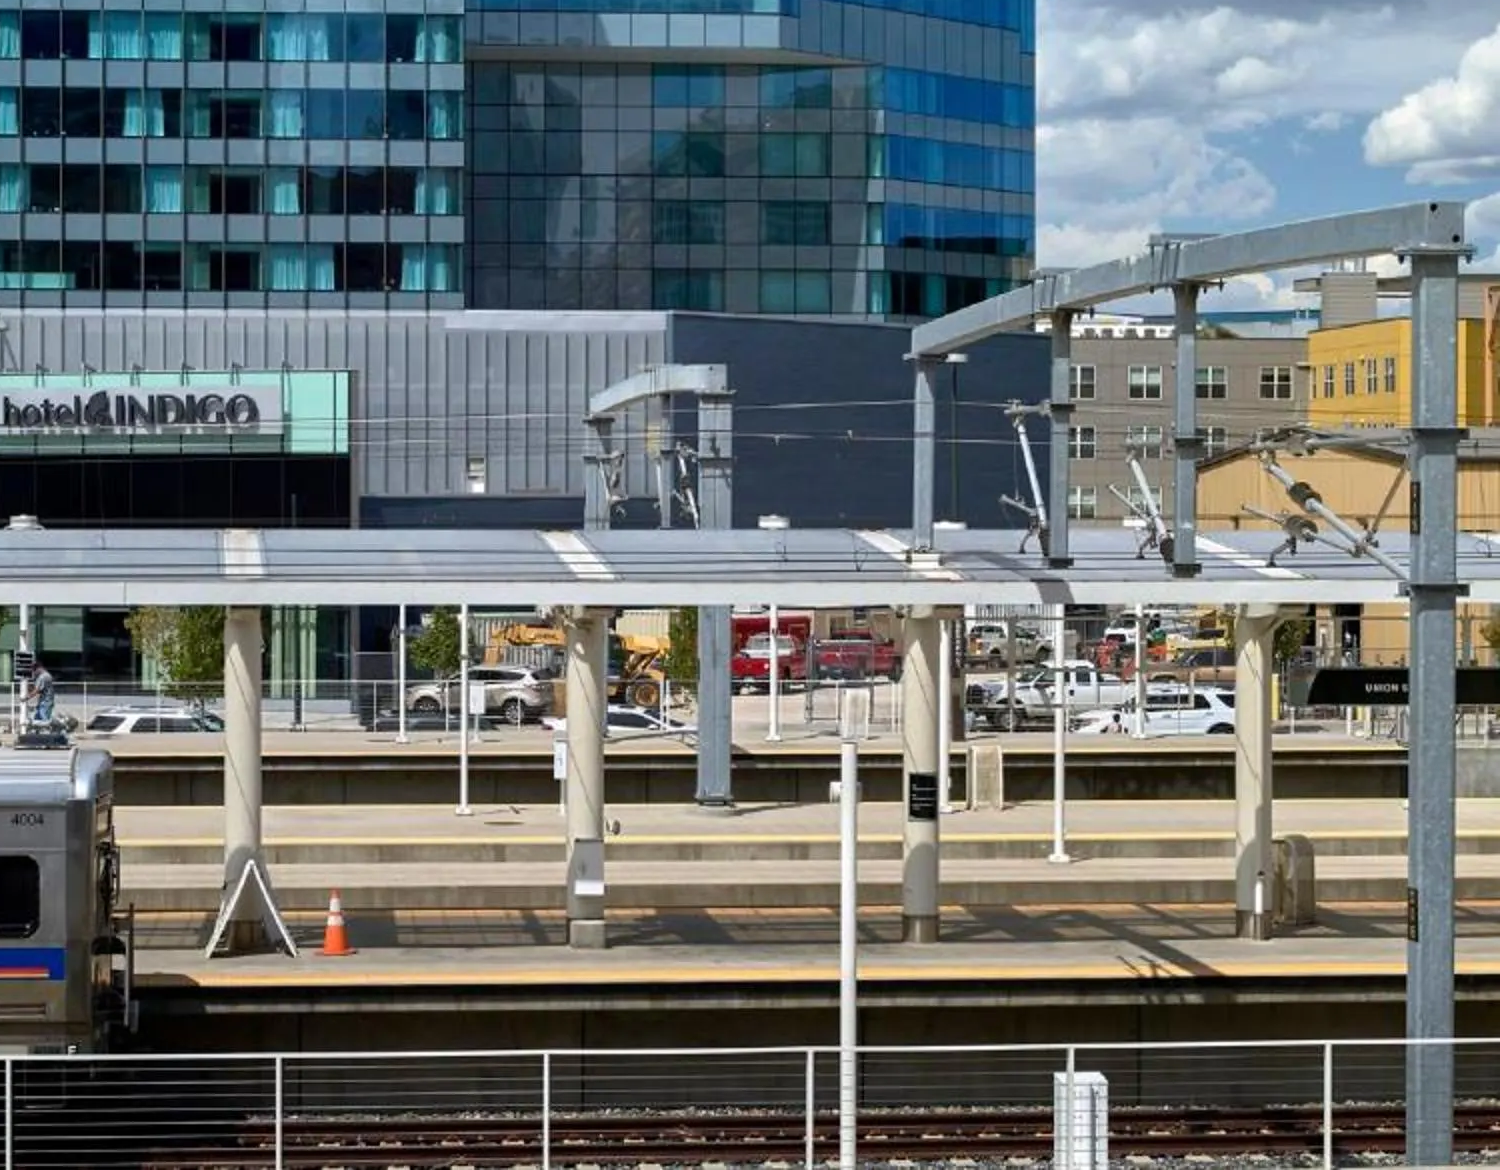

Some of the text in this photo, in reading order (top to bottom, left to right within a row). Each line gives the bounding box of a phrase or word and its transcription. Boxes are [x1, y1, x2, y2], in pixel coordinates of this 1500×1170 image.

[3, 393, 261, 429] hotel INDIGO
[1365, 683, 1399, 693] UNION
[10, 813, 45, 827] 4004
